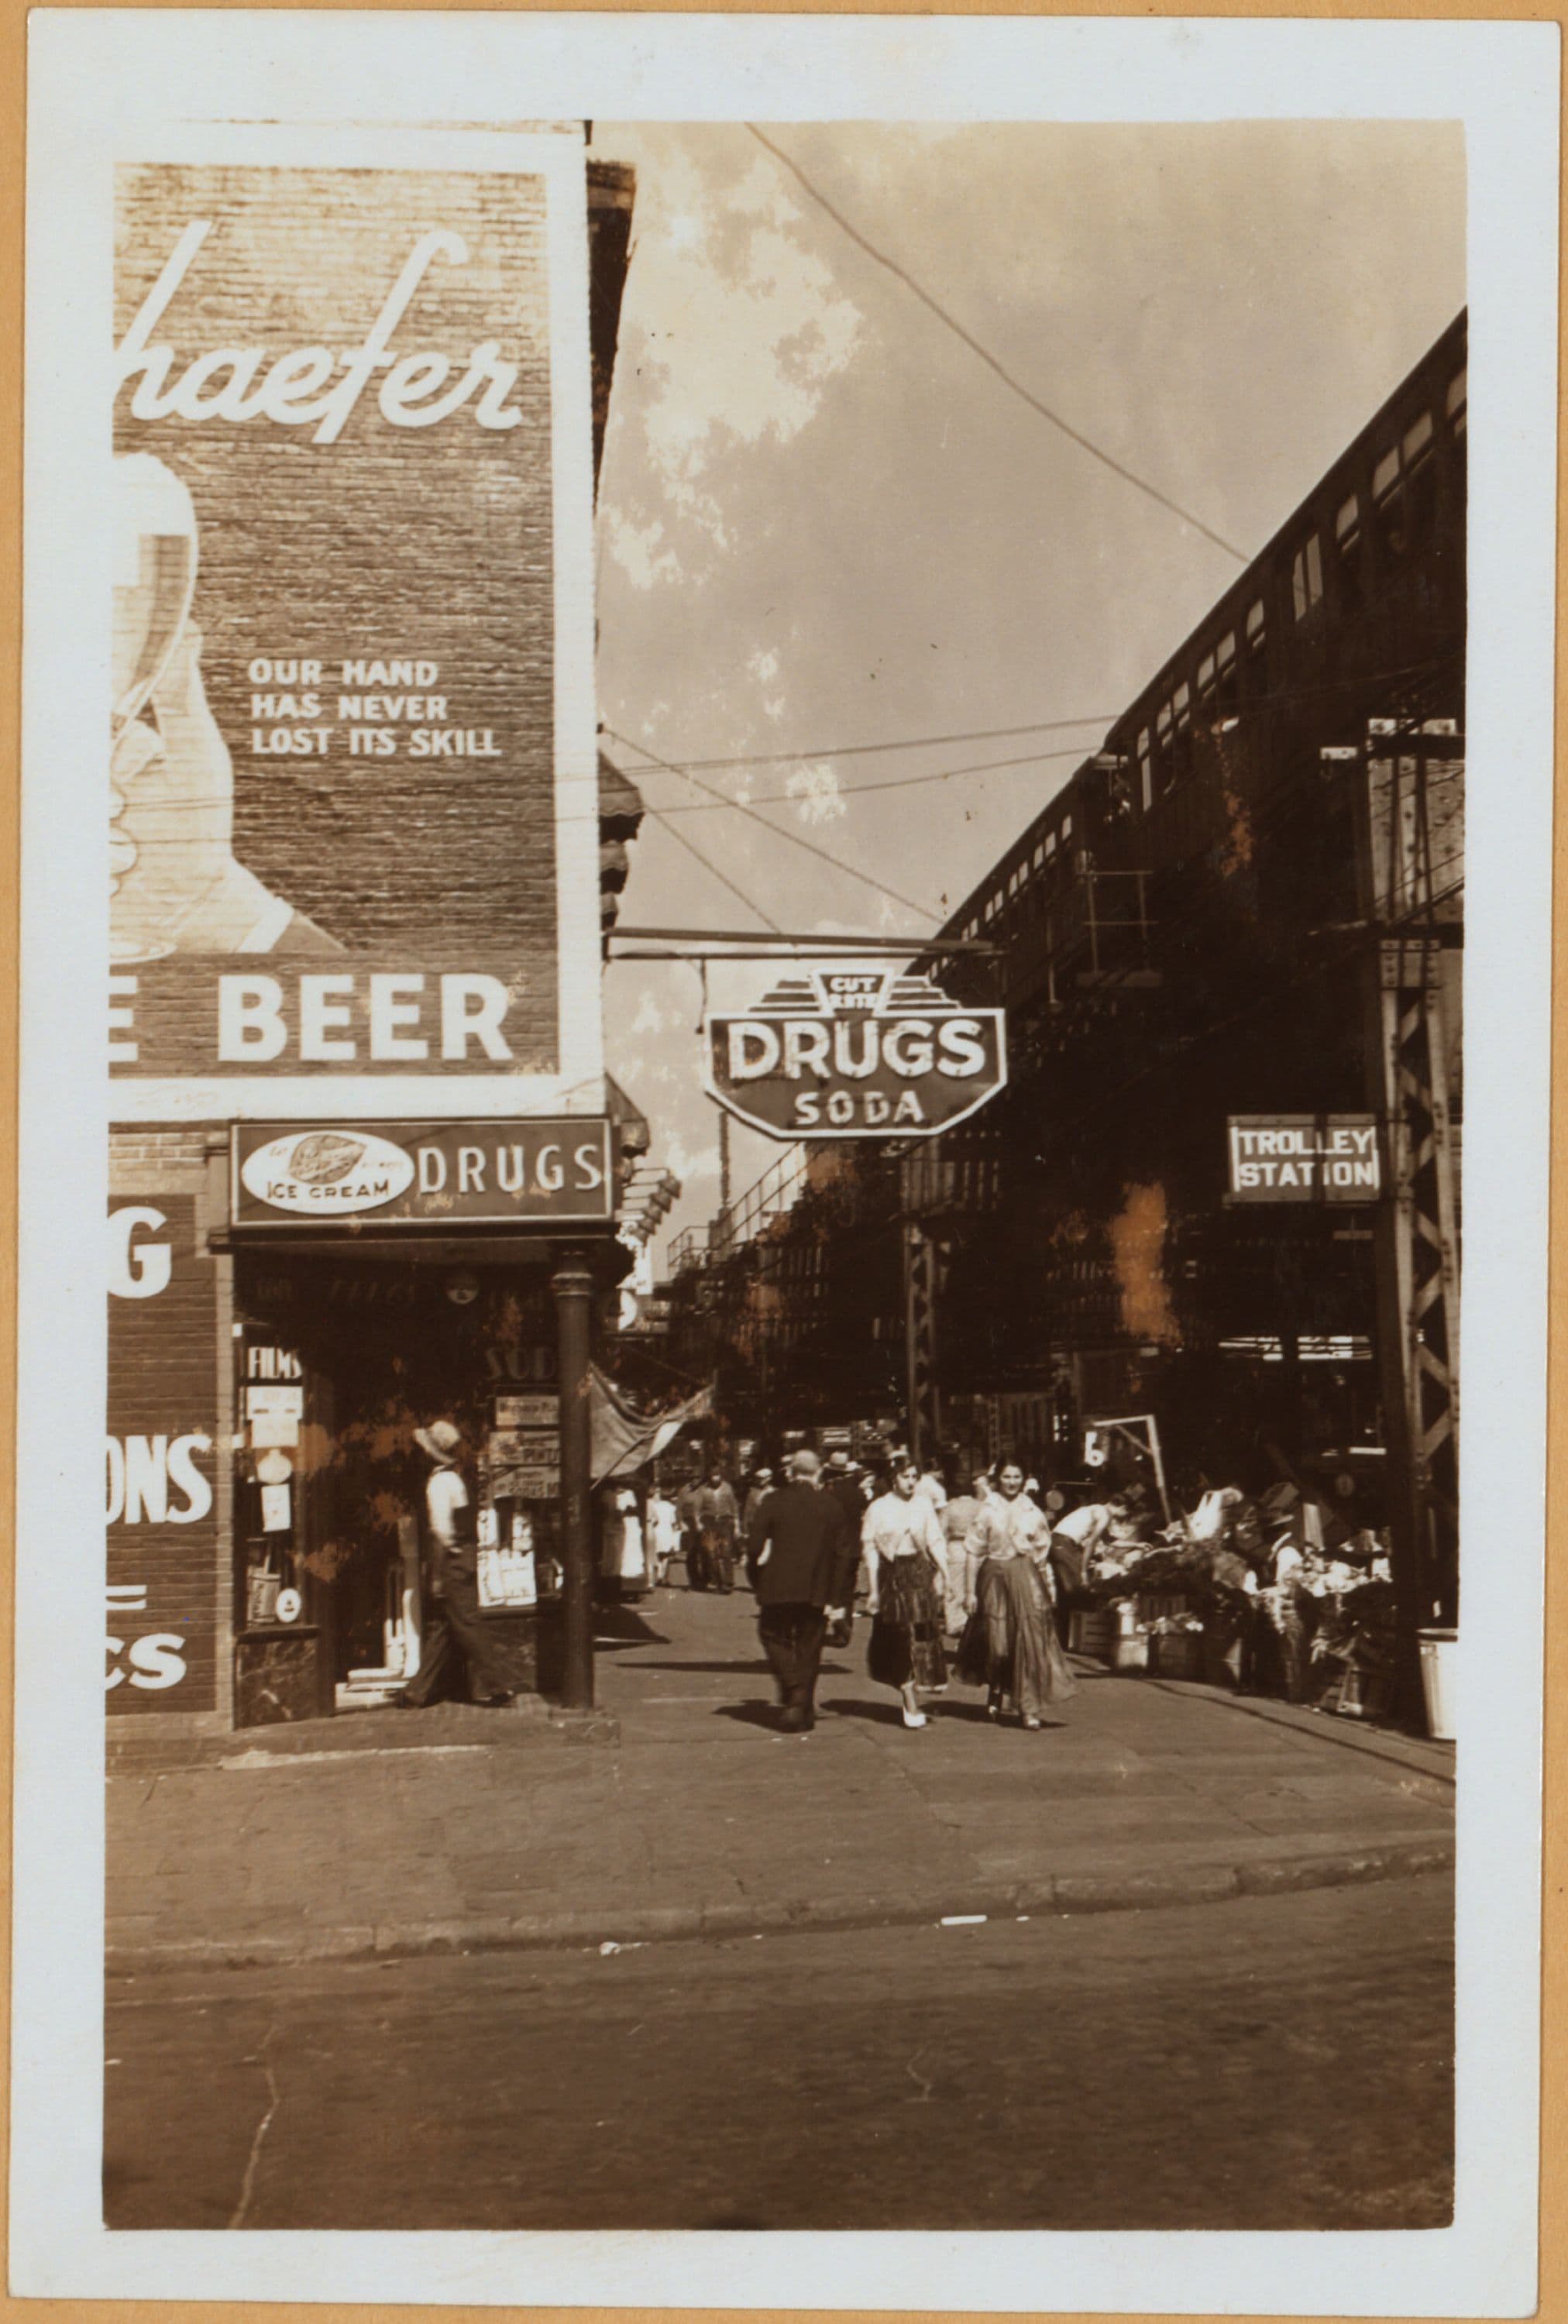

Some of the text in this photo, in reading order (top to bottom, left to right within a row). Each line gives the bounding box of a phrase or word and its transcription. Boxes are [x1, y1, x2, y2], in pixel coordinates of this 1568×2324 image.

[247, 658, 438, 687] OUR HAND
[250, 694, 448, 720] HAS NEVER
[251, 727, 502, 756] LOST ITS SKILL
[830, 977, 876, 992] CUT
[218, 974, 514, 1062] BEER
[727, 1020, 986, 1079] DRUGS
[793, 1091, 924, 1124] SODA
[1240, 1130, 1370, 1155] TROLLEY
[418, 1143, 601, 1194] DRUGS
[1240, 1162, 1373, 1187] STATION
[266, 1179, 389, 1199] ICE CREAM
